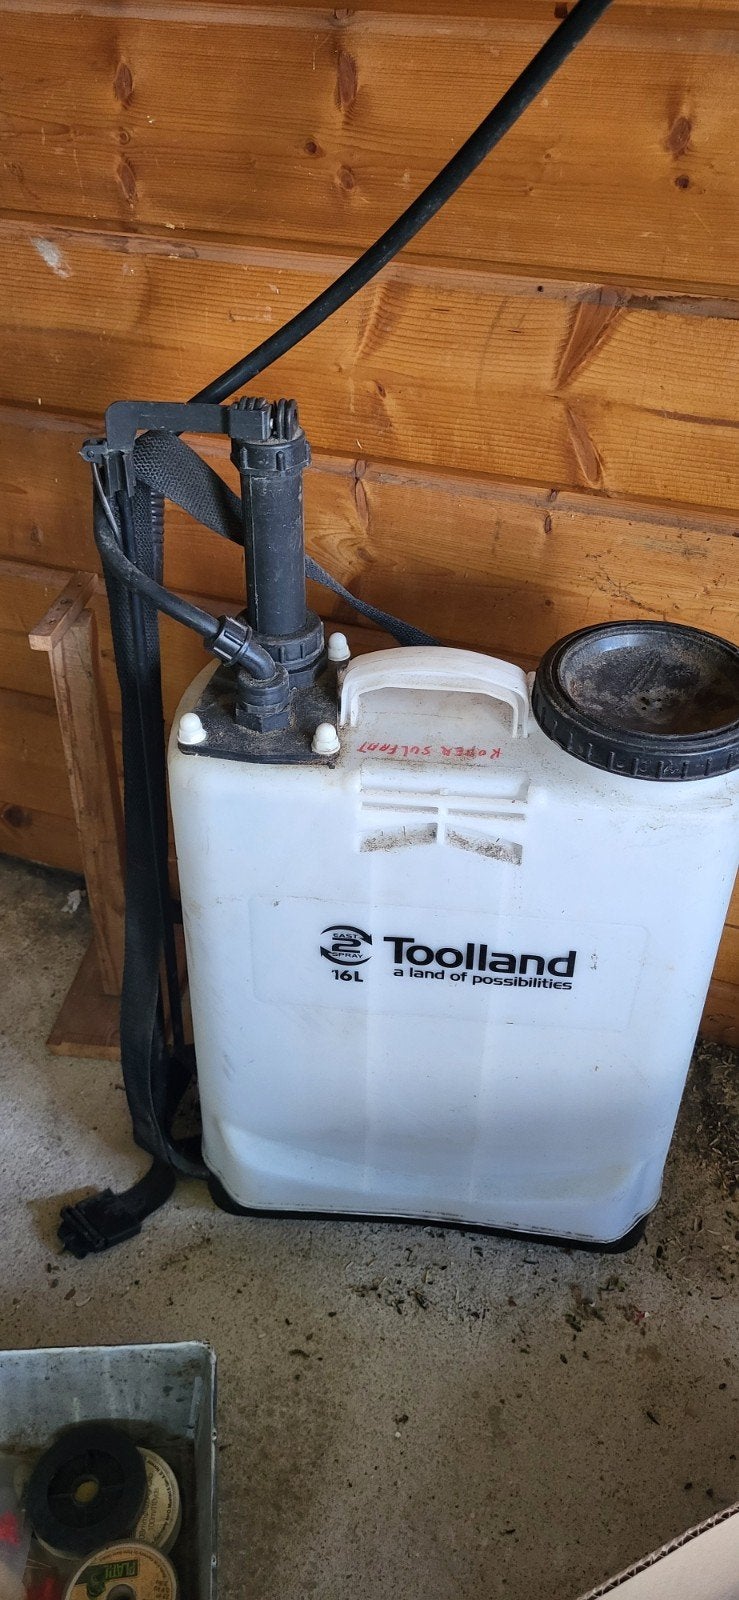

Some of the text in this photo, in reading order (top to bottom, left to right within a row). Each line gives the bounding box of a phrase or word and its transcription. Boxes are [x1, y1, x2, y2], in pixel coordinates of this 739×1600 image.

[332, 937, 361, 953] 2
[331, 951, 364, 959] SPRAY
[383, 936, 577, 978] Toolland
[331, 969, 364, 982] 16L
[393, 966, 573, 990] a land of possibilities
